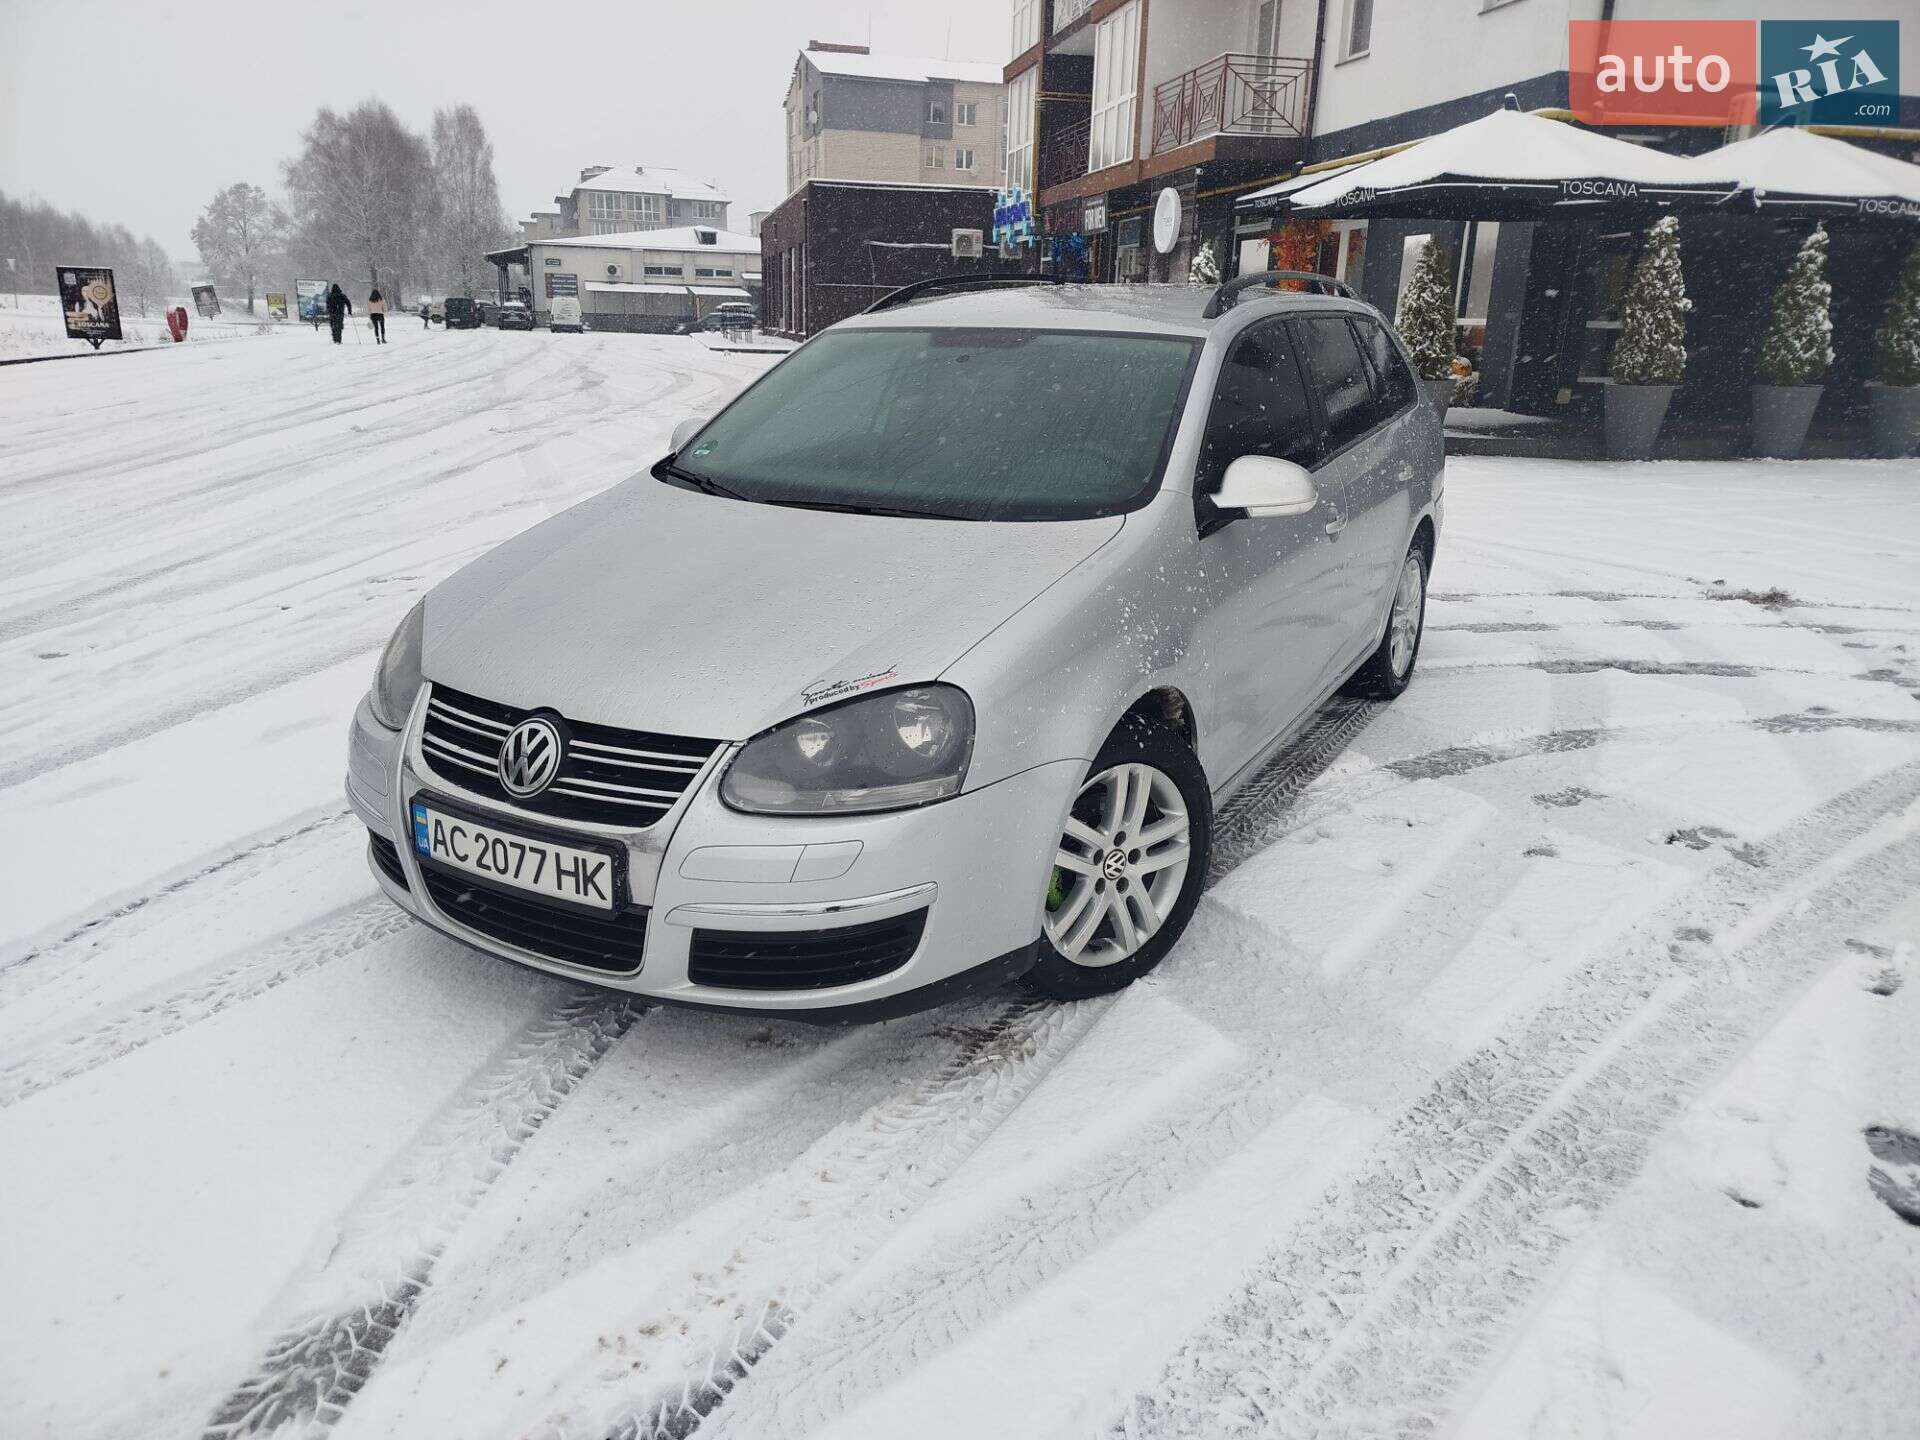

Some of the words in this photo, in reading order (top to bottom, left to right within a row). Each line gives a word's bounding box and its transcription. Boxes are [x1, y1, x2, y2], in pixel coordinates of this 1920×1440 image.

[1336, 187, 1377, 207] TOSCANA
[1560, 180, 1638, 197] TOSCANA
[1254, 196, 1278, 208] TOSCANA
[1858, 198, 1920, 215] TOSCAN
[809, 685, 850, 704] produced
[849, 684, 861, 692] by
[417, 836, 430, 849] UA
[433, 818, 469, 862] AC
[474, 832, 547, 885] 2077
[555, 851, 608, 901] HK
